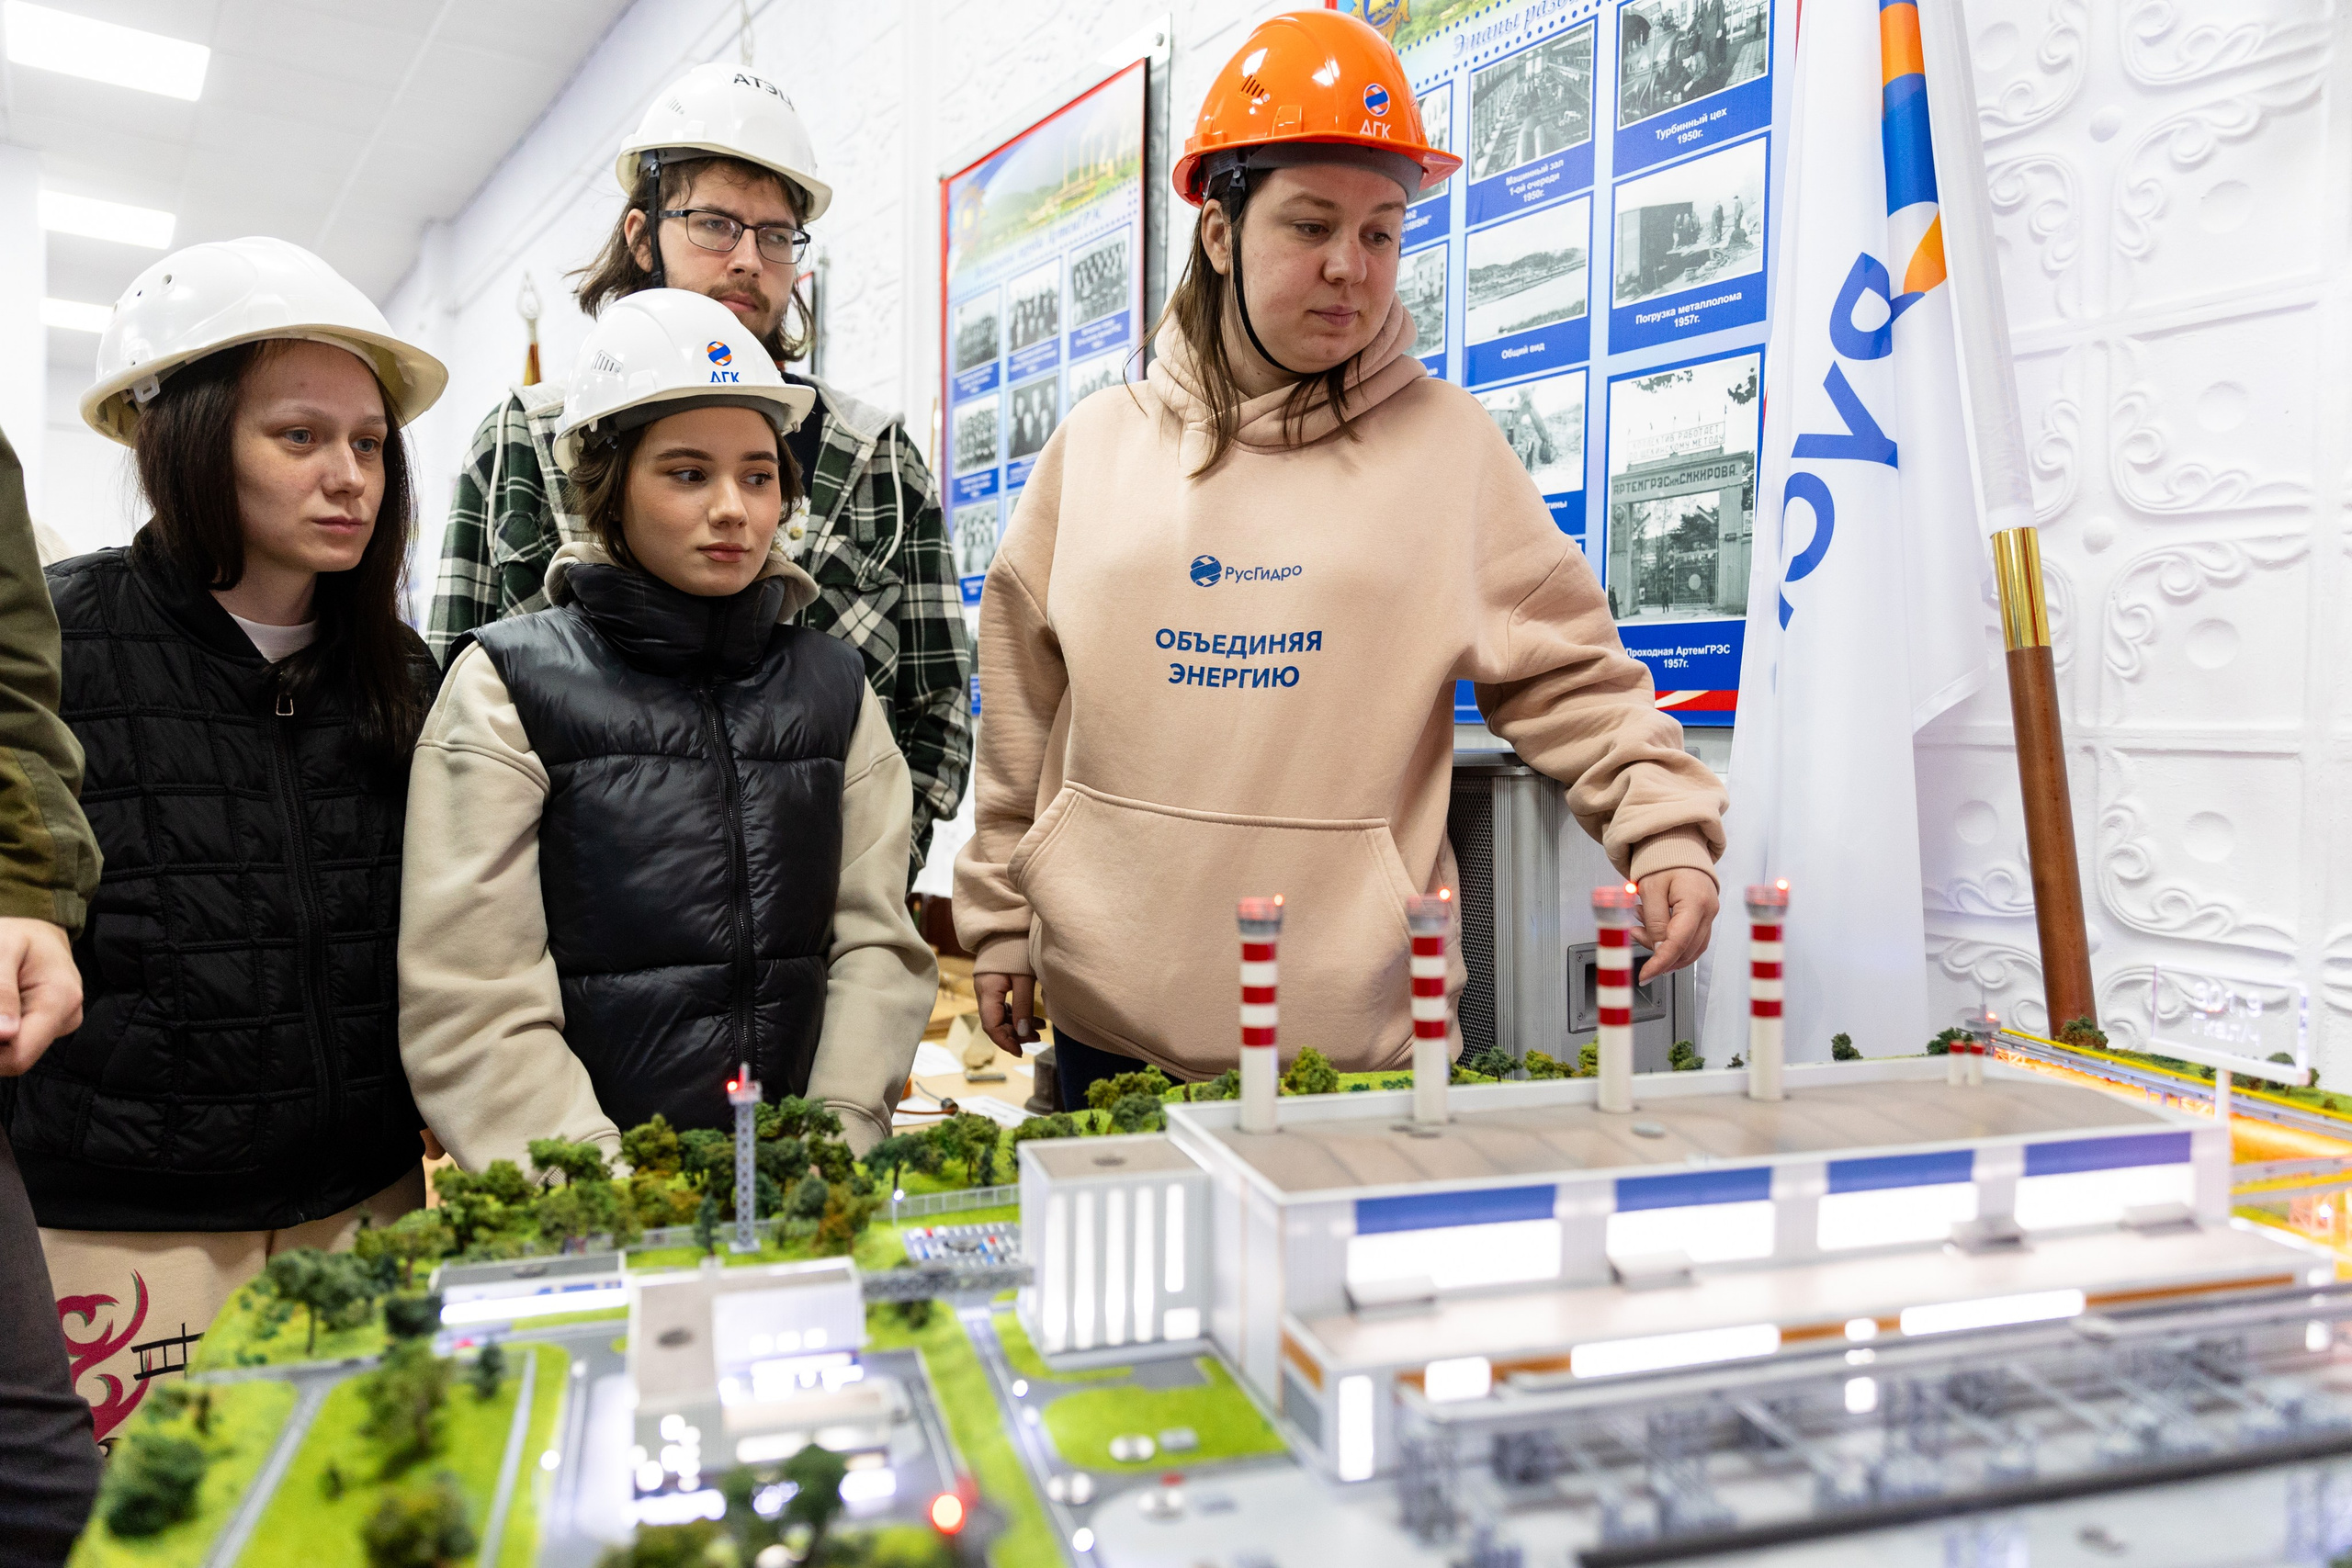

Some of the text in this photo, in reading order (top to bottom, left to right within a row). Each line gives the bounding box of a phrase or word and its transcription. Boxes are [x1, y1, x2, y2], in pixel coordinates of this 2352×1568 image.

[1453, 13, 1519, 58] Этапы
[733, 73, 796, 112] АТЭЦ
[1359, 118, 1392, 140] ДГК
[1655, 107, 1727, 141] Турбинный цех
[1677, 129, 1704, 144] 1950г.
[1506, 159, 1565, 186] Машинный зал
[1635, 291, 1743, 325] Погрузка металлолома
[1674, 313, 1701, 328] 1957г.
[1501, 343, 1545, 359] Общий вид
[709, 370, 741, 383] ДГК
[1678, 424, 1720, 441] РАБОТАЕТ
[1691, 434, 1724, 447] МЕТОДУ
[1613, 477, 1669, 496] АРТЕМГРЭС
[1225, 565, 1303, 583] РусГидро
[1155, 627, 1323, 660] ОБЪЕДИНЯЯ
[1625, 644, 1731, 659] Проходная АртемГРЭС
[1663, 659, 1690, 669] 1957г.
[1168, 662, 1300, 689] ЭНЕРГИЮ
